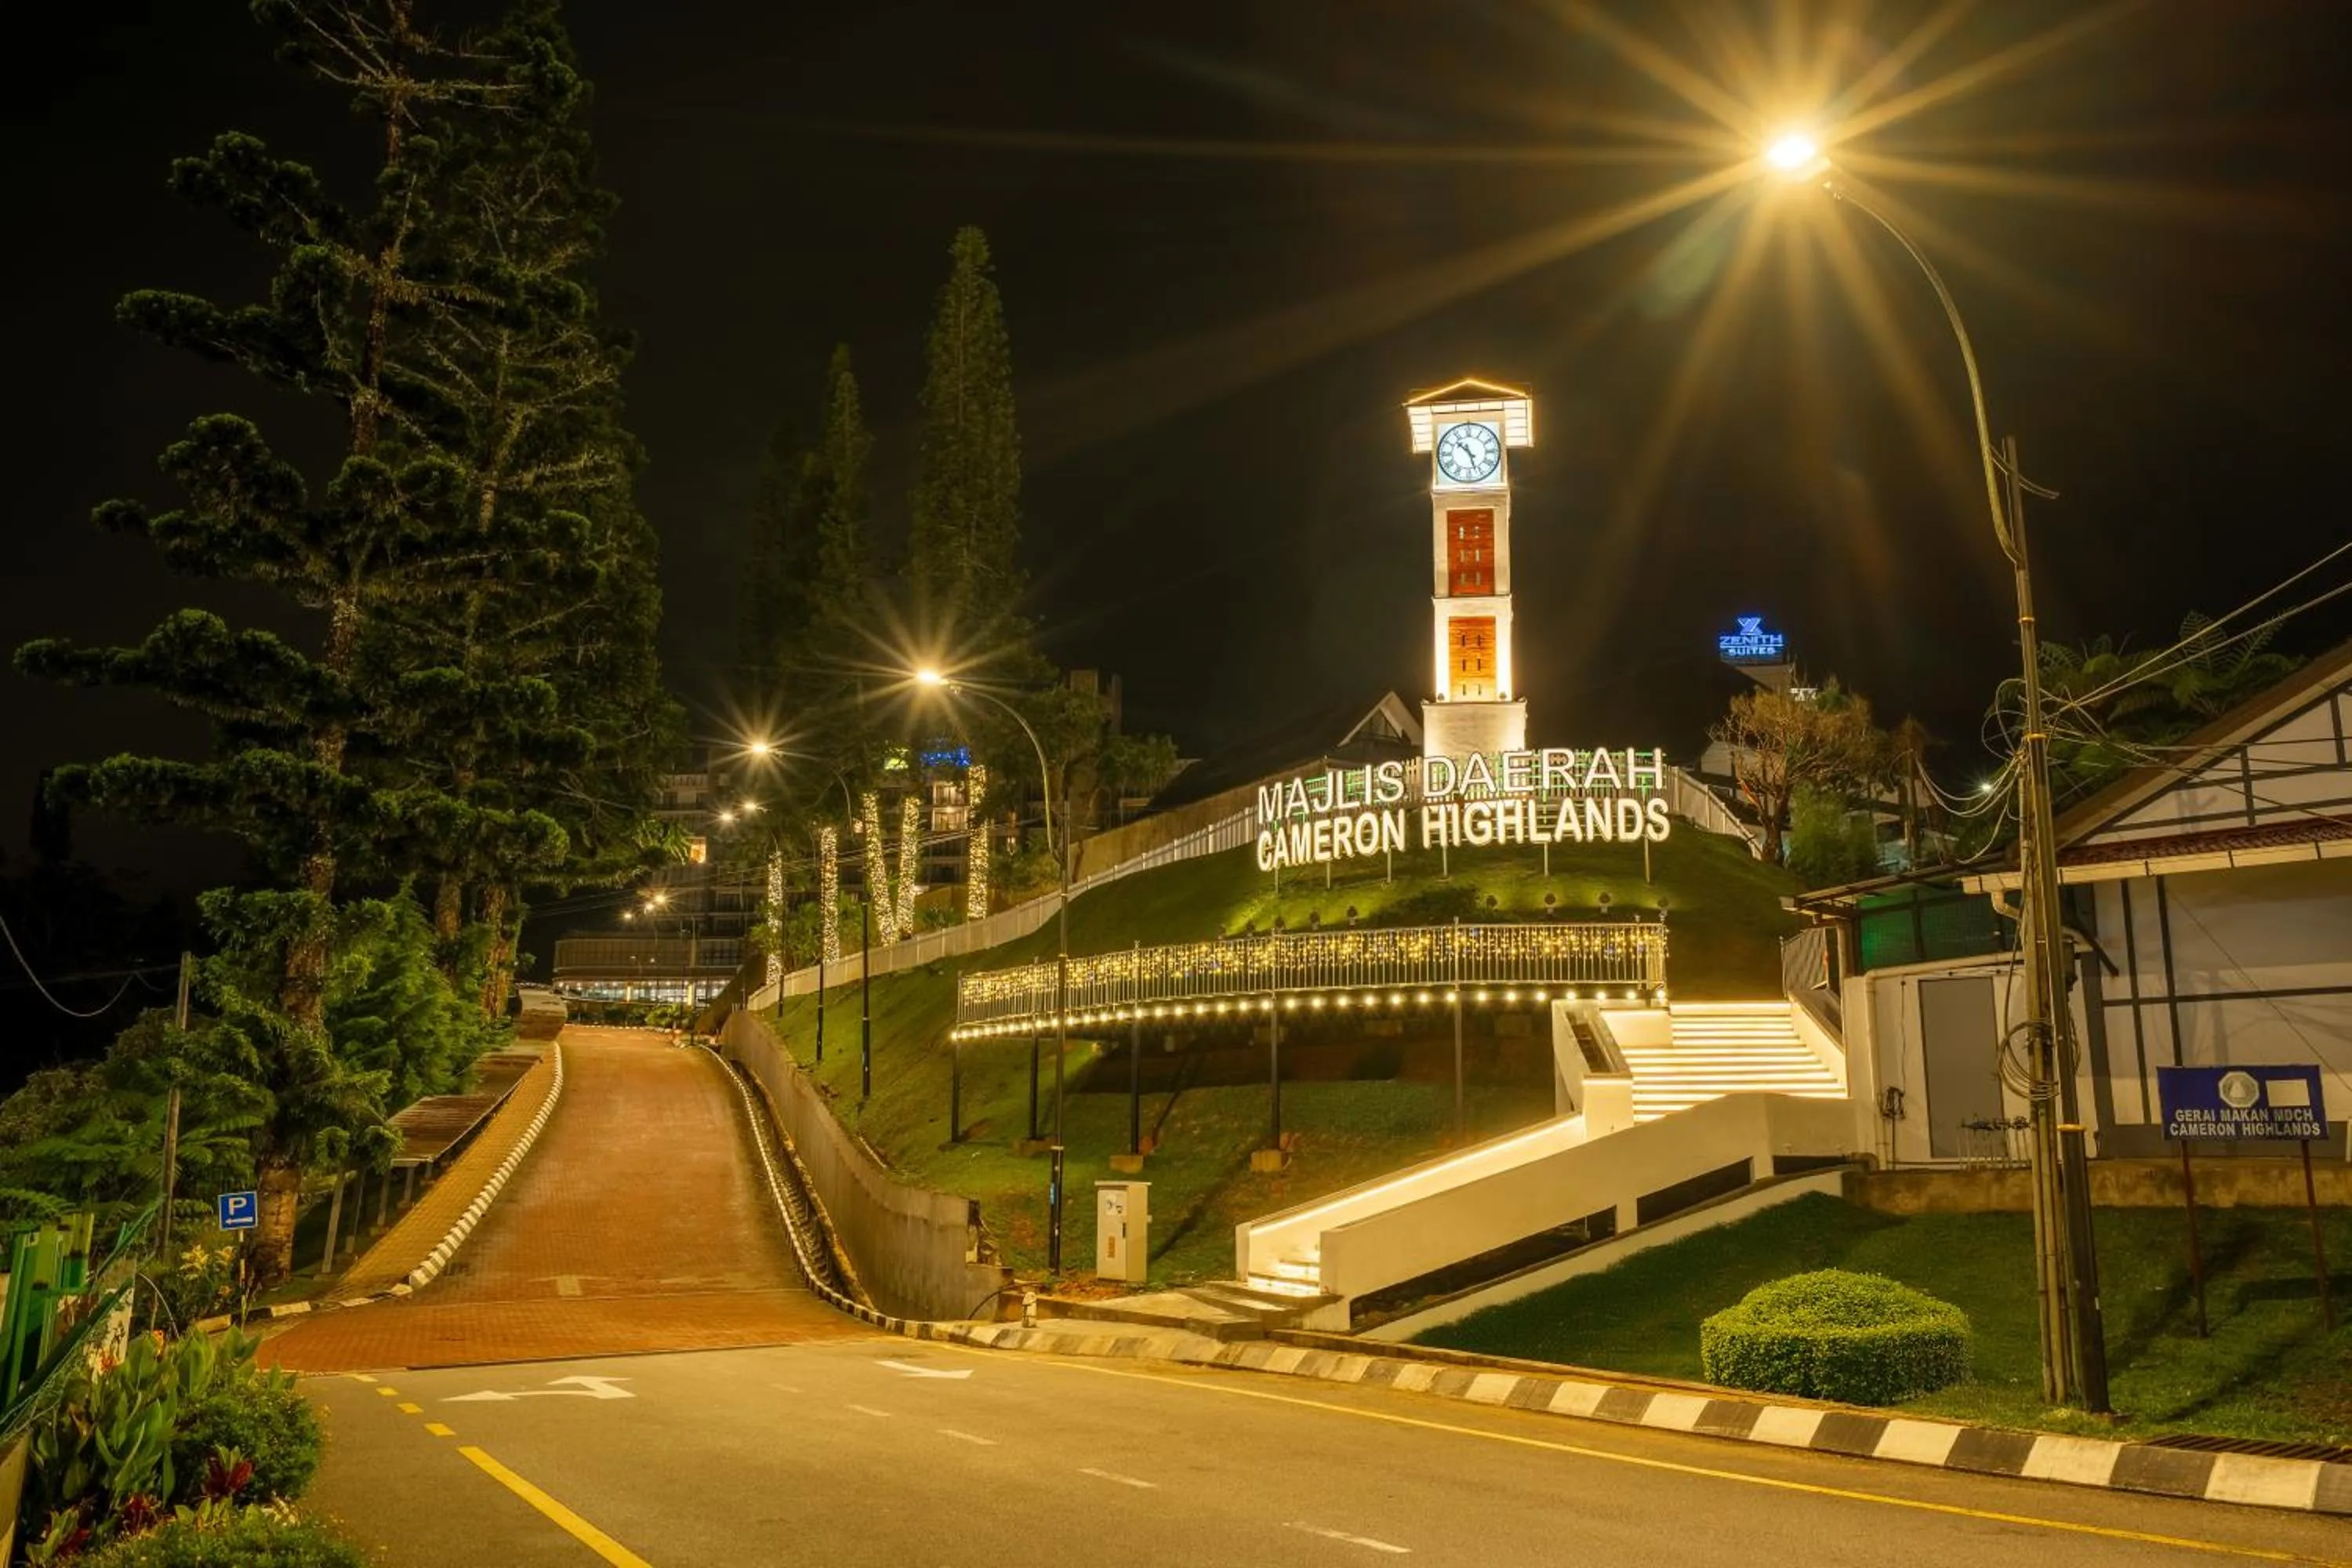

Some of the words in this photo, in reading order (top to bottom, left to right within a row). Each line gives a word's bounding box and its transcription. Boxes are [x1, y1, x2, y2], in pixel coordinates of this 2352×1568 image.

[1719, 634, 1782, 645] ZENITH
[1728, 647, 1776, 656] SUITES
[1257, 760, 1406, 825] MAJLIS
[1421, 746, 1664, 798] DAERAH
[1257, 808, 1406, 872] CAMERON
[1421, 797, 1671, 849] HIGHLANDS
[2175, 1109, 2216, 1122] GERAI
[2220, 1109, 2269, 1122] MAKAN
[2273, 1109, 2313, 1122] MDCH
[2169, 1122, 2235, 1136] CAMERON
[2241, 1122, 2321, 1136] HIGHLANDS
[228, 1197, 247, 1216] P
